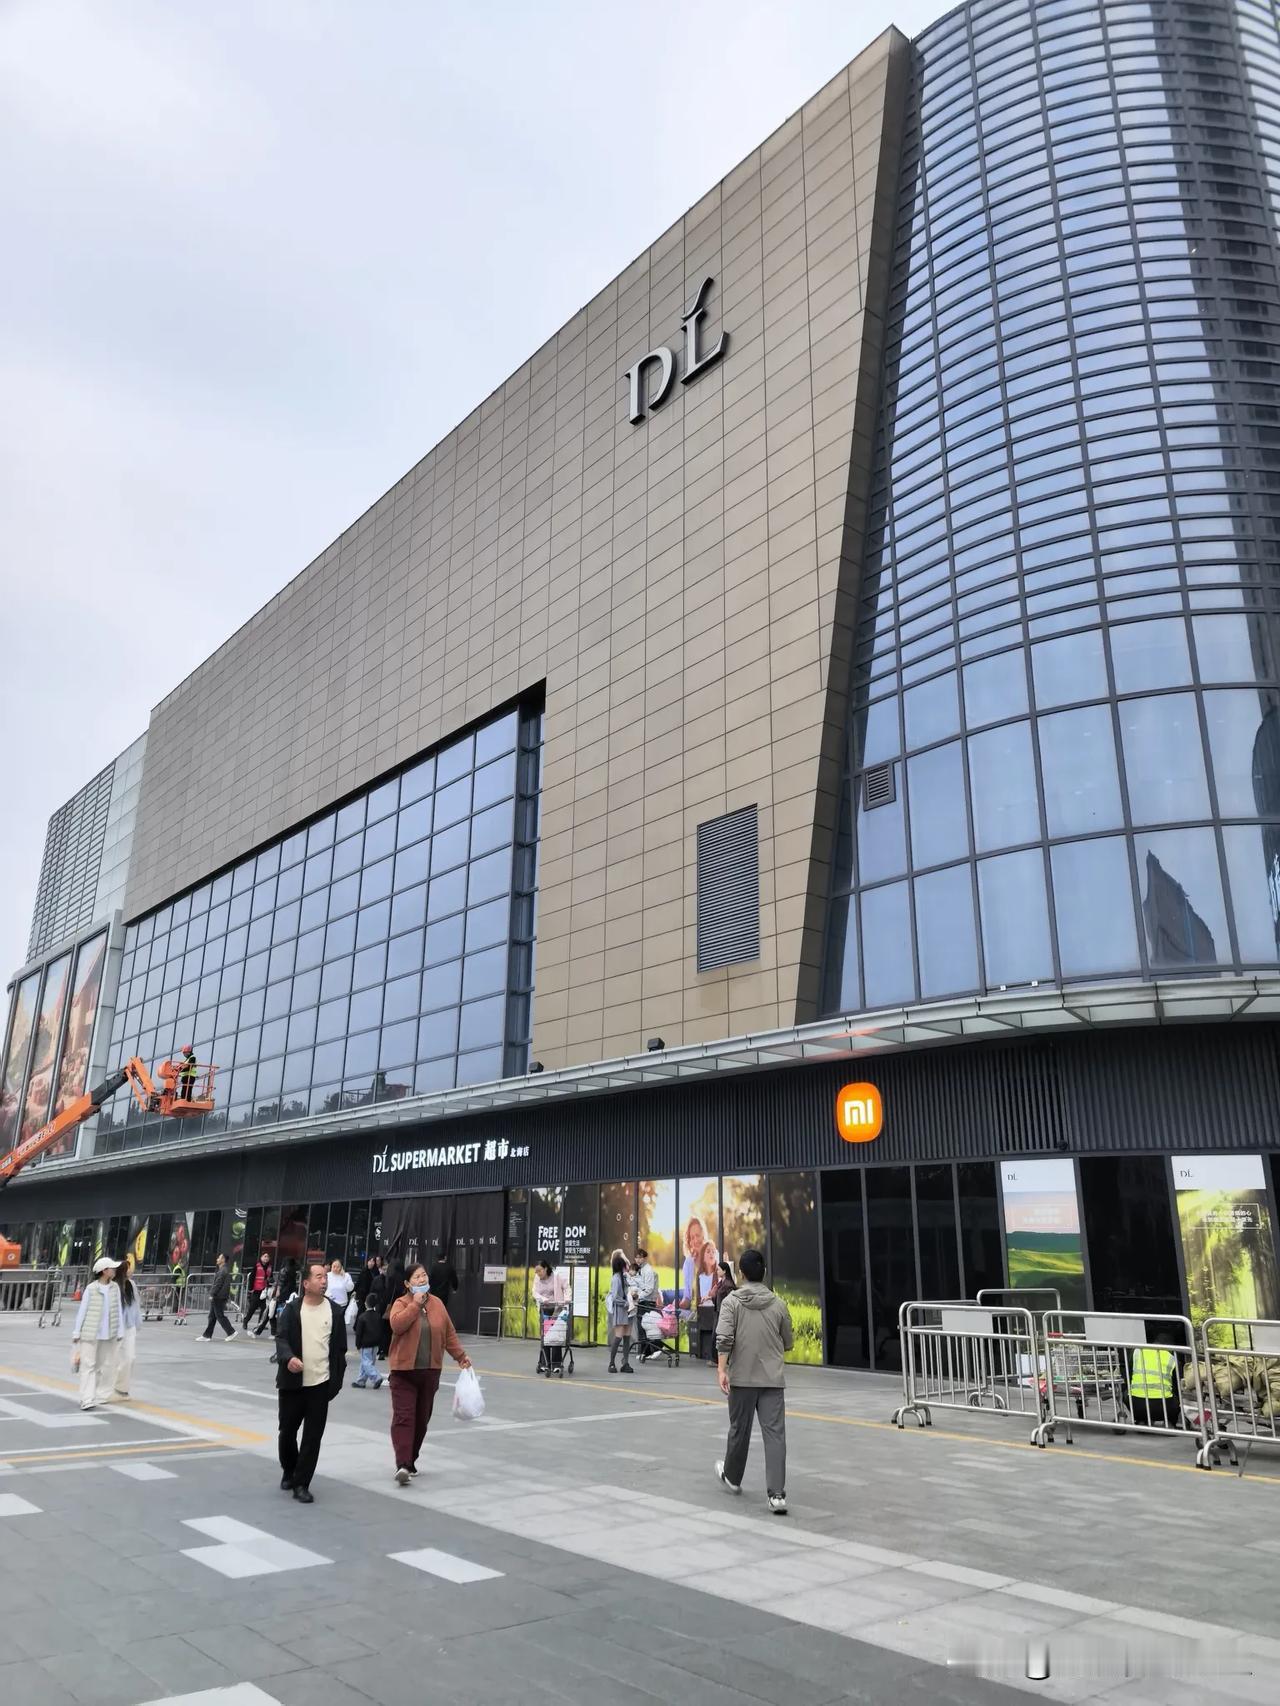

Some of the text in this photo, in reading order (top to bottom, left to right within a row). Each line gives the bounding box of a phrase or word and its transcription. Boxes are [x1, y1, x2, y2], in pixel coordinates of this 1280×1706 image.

[391, 1143, 481, 1171] SUPERMARKET
[484, 1138, 509, 1160] 超市
[538, 1225, 586, 1239] FREE DOM
[537, 1239, 560, 1252] LOVE
